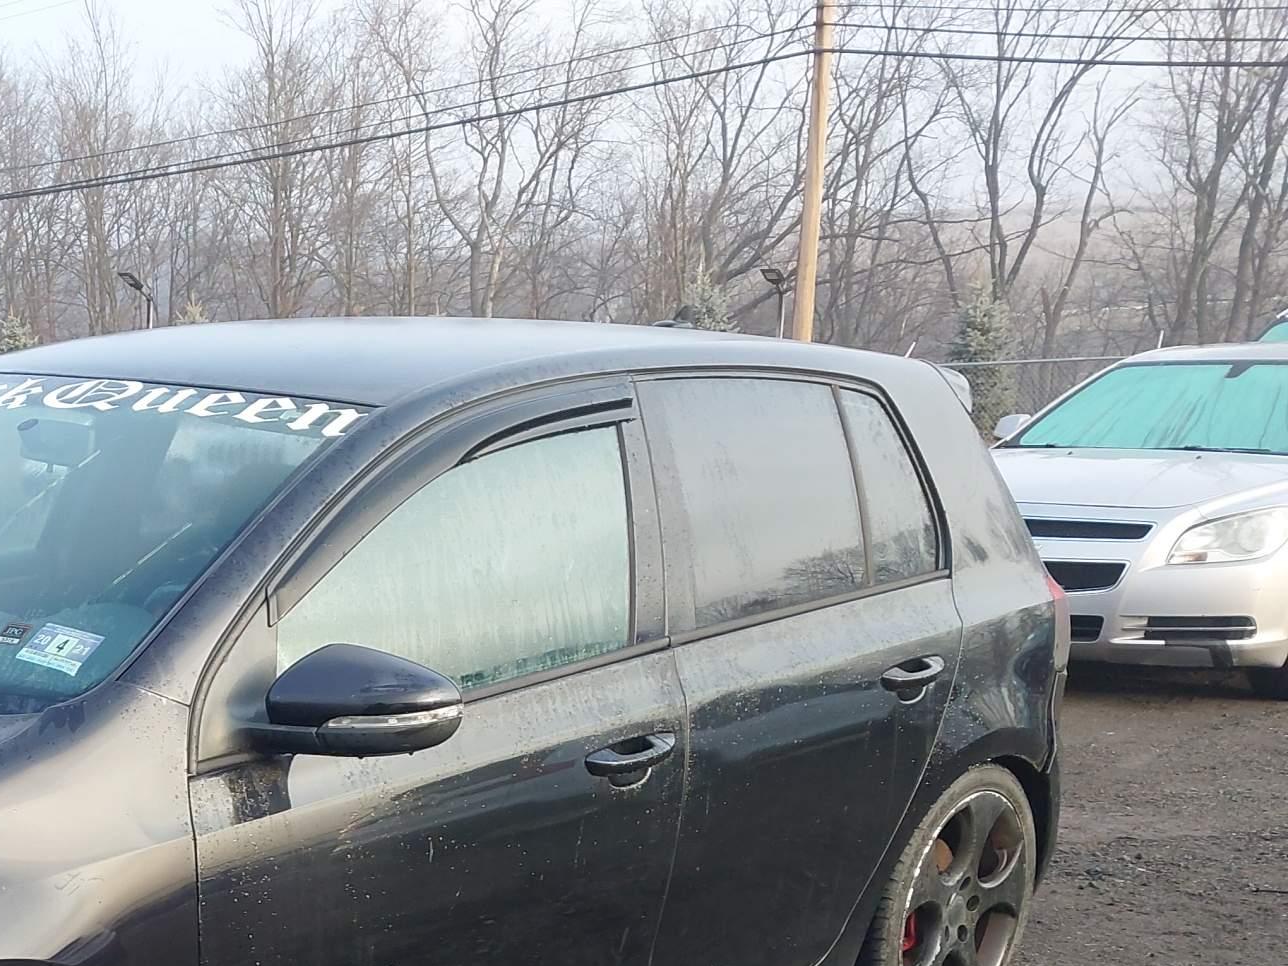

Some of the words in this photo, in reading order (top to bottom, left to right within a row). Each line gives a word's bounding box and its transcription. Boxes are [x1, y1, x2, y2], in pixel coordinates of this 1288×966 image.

[42, 379, 369, 438] Queen
[33, 633, 52, 646] 20
[55, 639, 70, 653] 4
